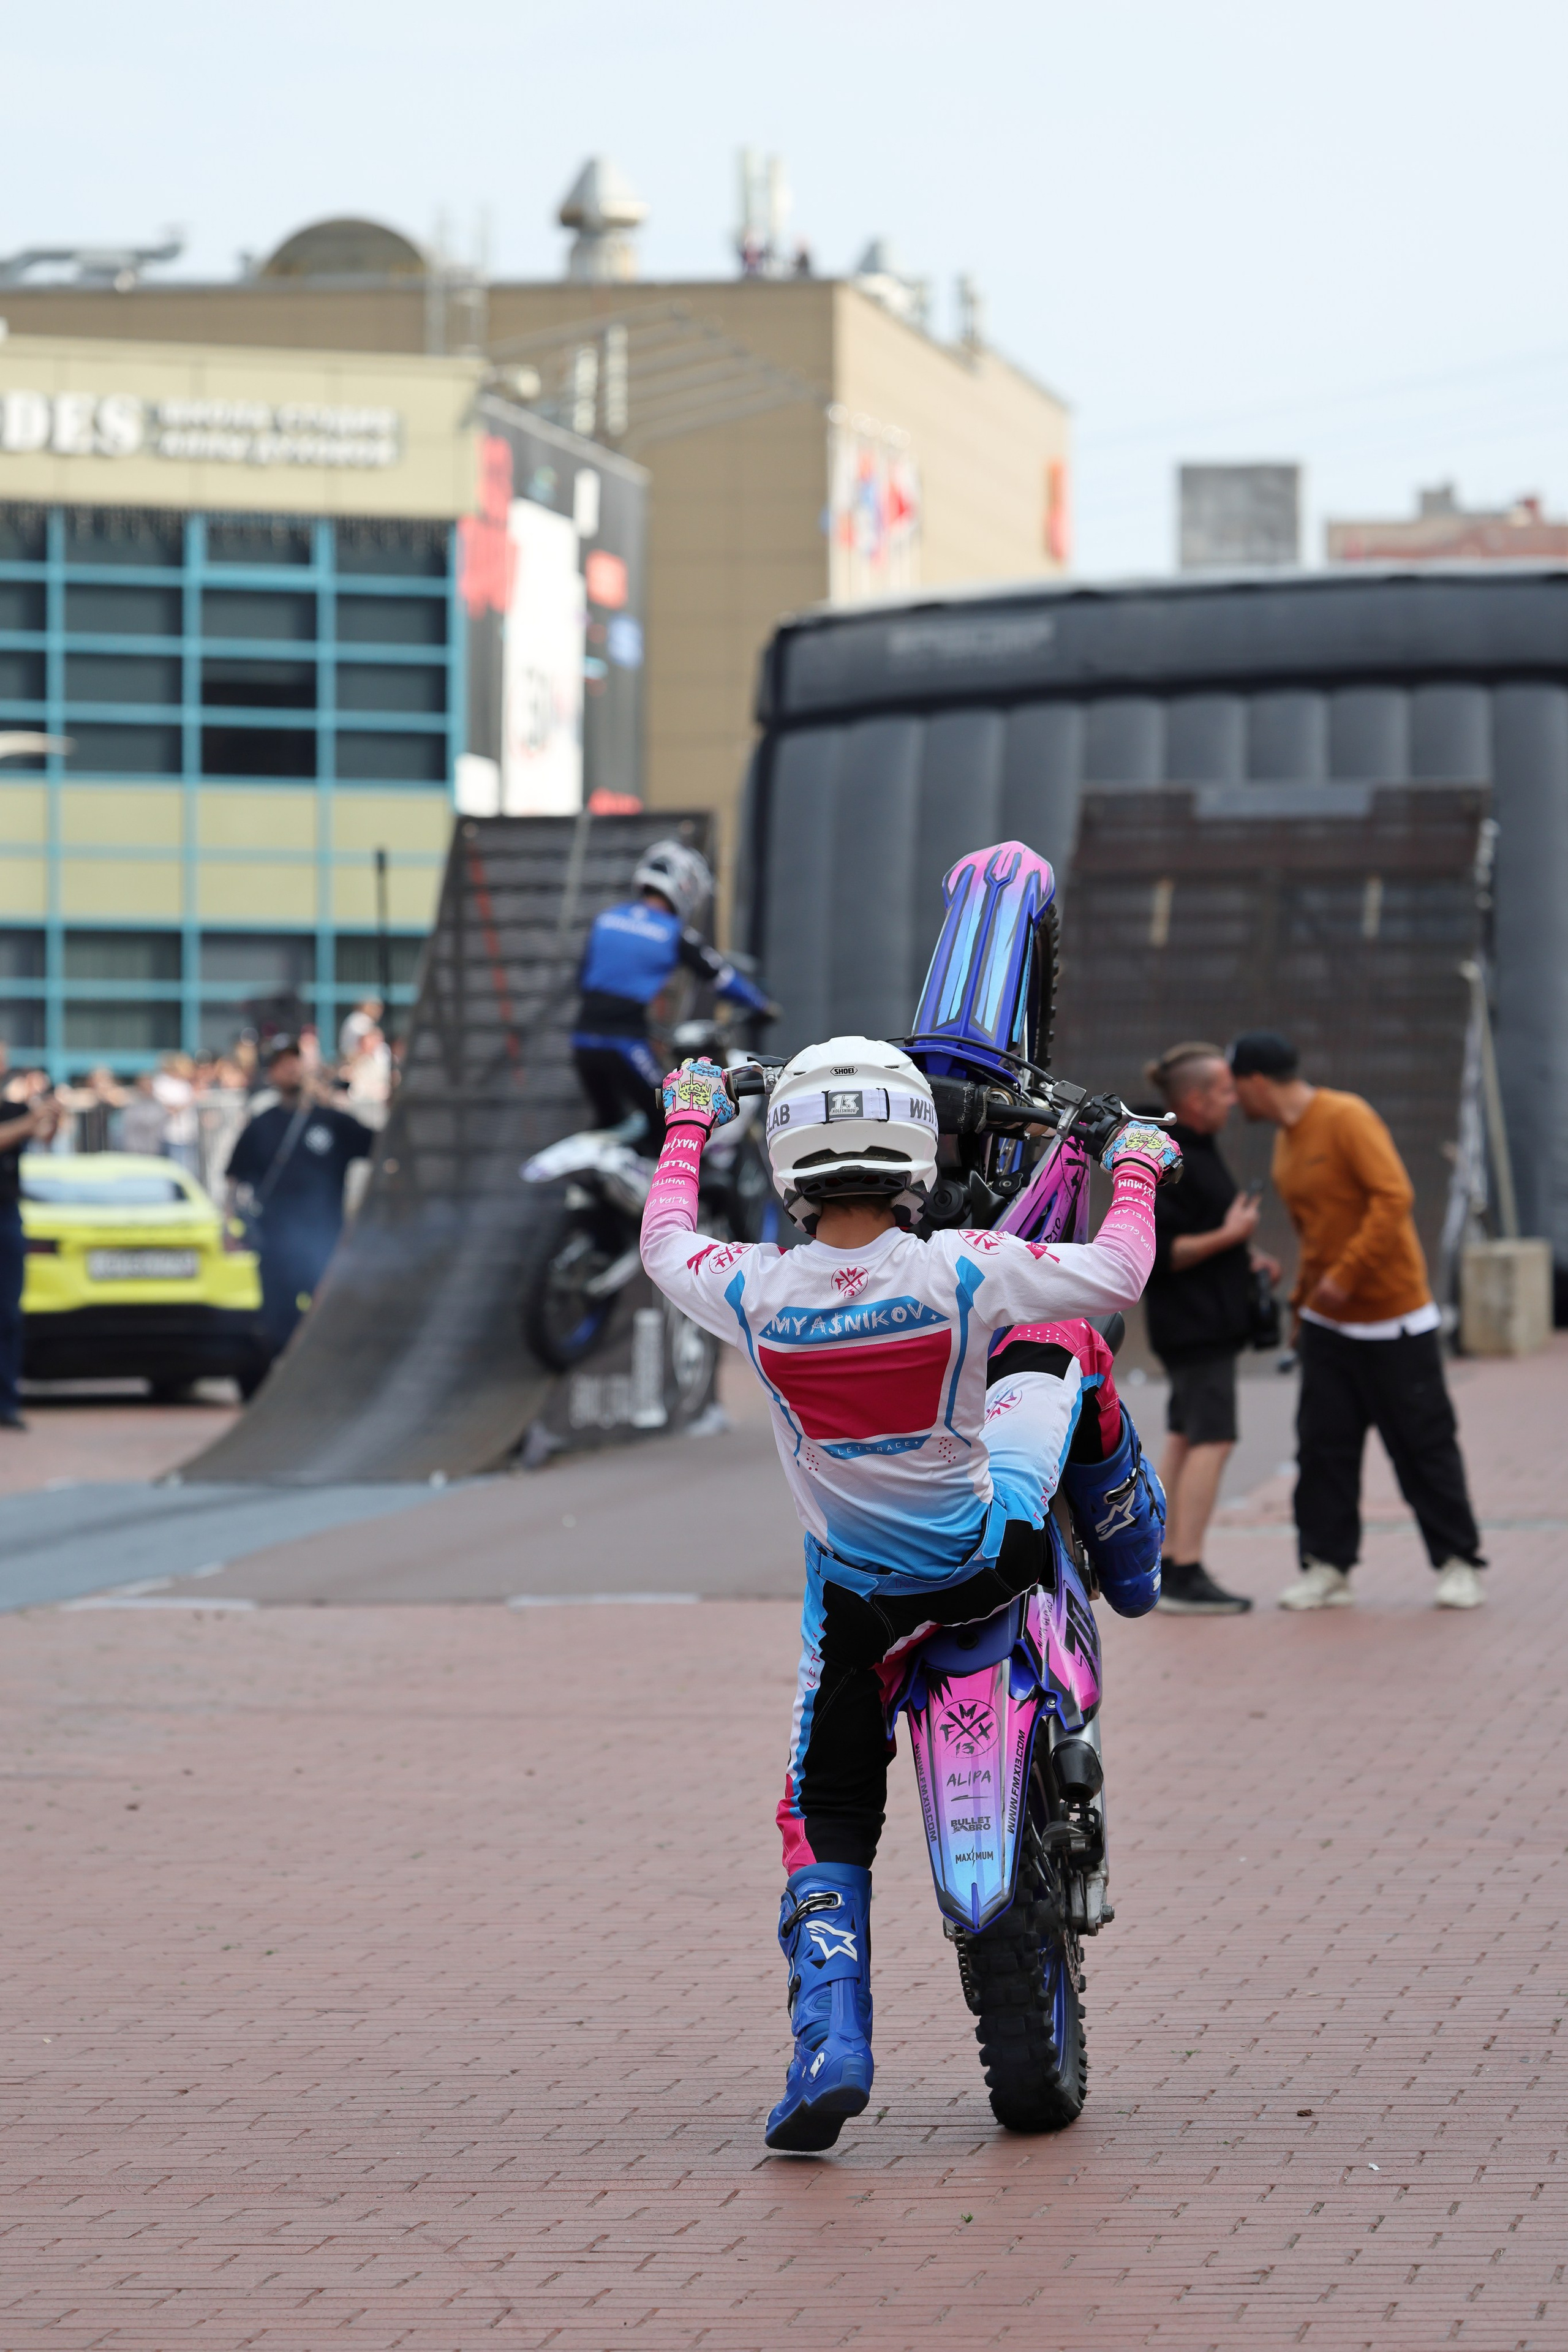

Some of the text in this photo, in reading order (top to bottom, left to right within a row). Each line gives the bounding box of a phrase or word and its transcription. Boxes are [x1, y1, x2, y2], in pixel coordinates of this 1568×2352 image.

[832, 1093, 859, 1109] 13
[946, 1770, 992, 1787] ALIPA
[1007, 1728, 1026, 1835] WWW.FMX13.COM
[914, 1743, 937, 1842] WWW.FMX13.COM
[951, 1816, 991, 1827] BULLET
[968, 1823, 991, 1832] BRO
[955, 1845, 994, 1866] MAXIMUM
